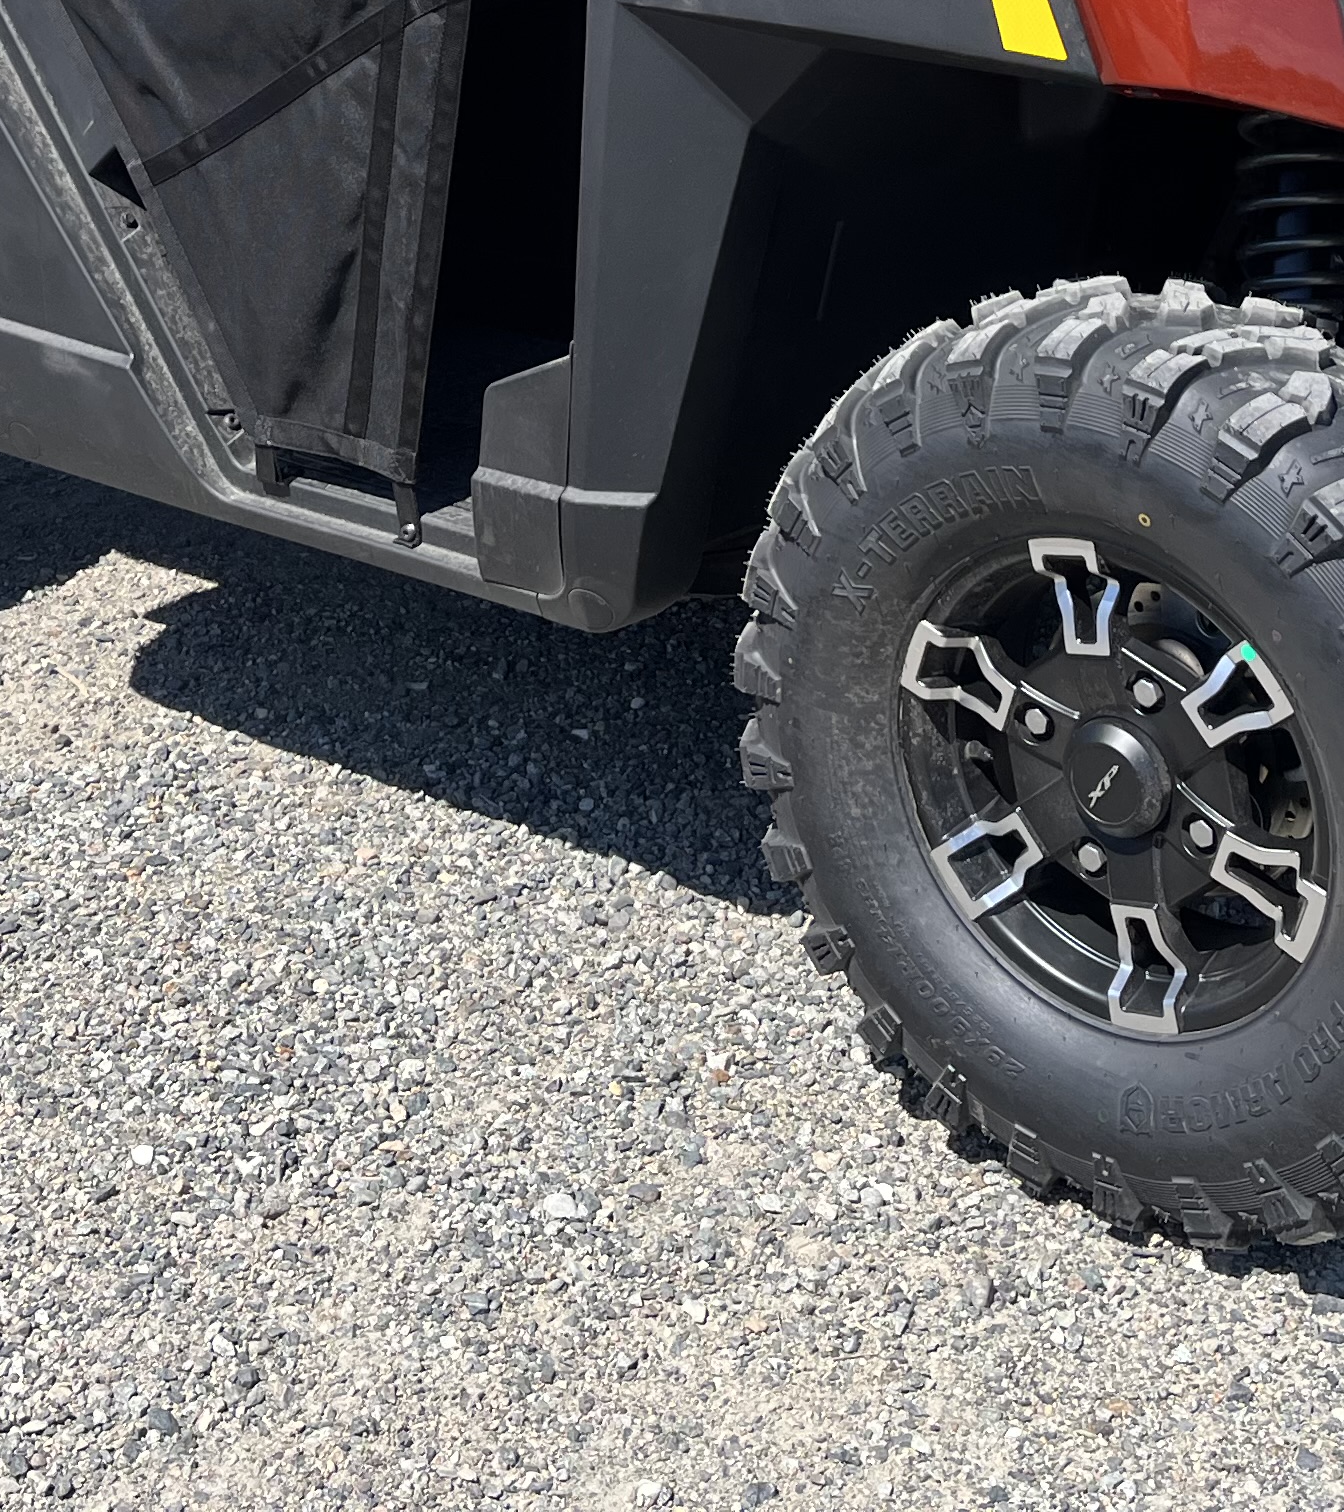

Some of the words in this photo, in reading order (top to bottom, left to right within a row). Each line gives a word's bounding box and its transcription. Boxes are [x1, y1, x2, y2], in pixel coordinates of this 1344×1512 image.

[831, 465, 1048, 616] X-TERRAIN
[1087, 764, 1120, 808] XP
[1160, 1062, 1292, 1134] ARMOR
